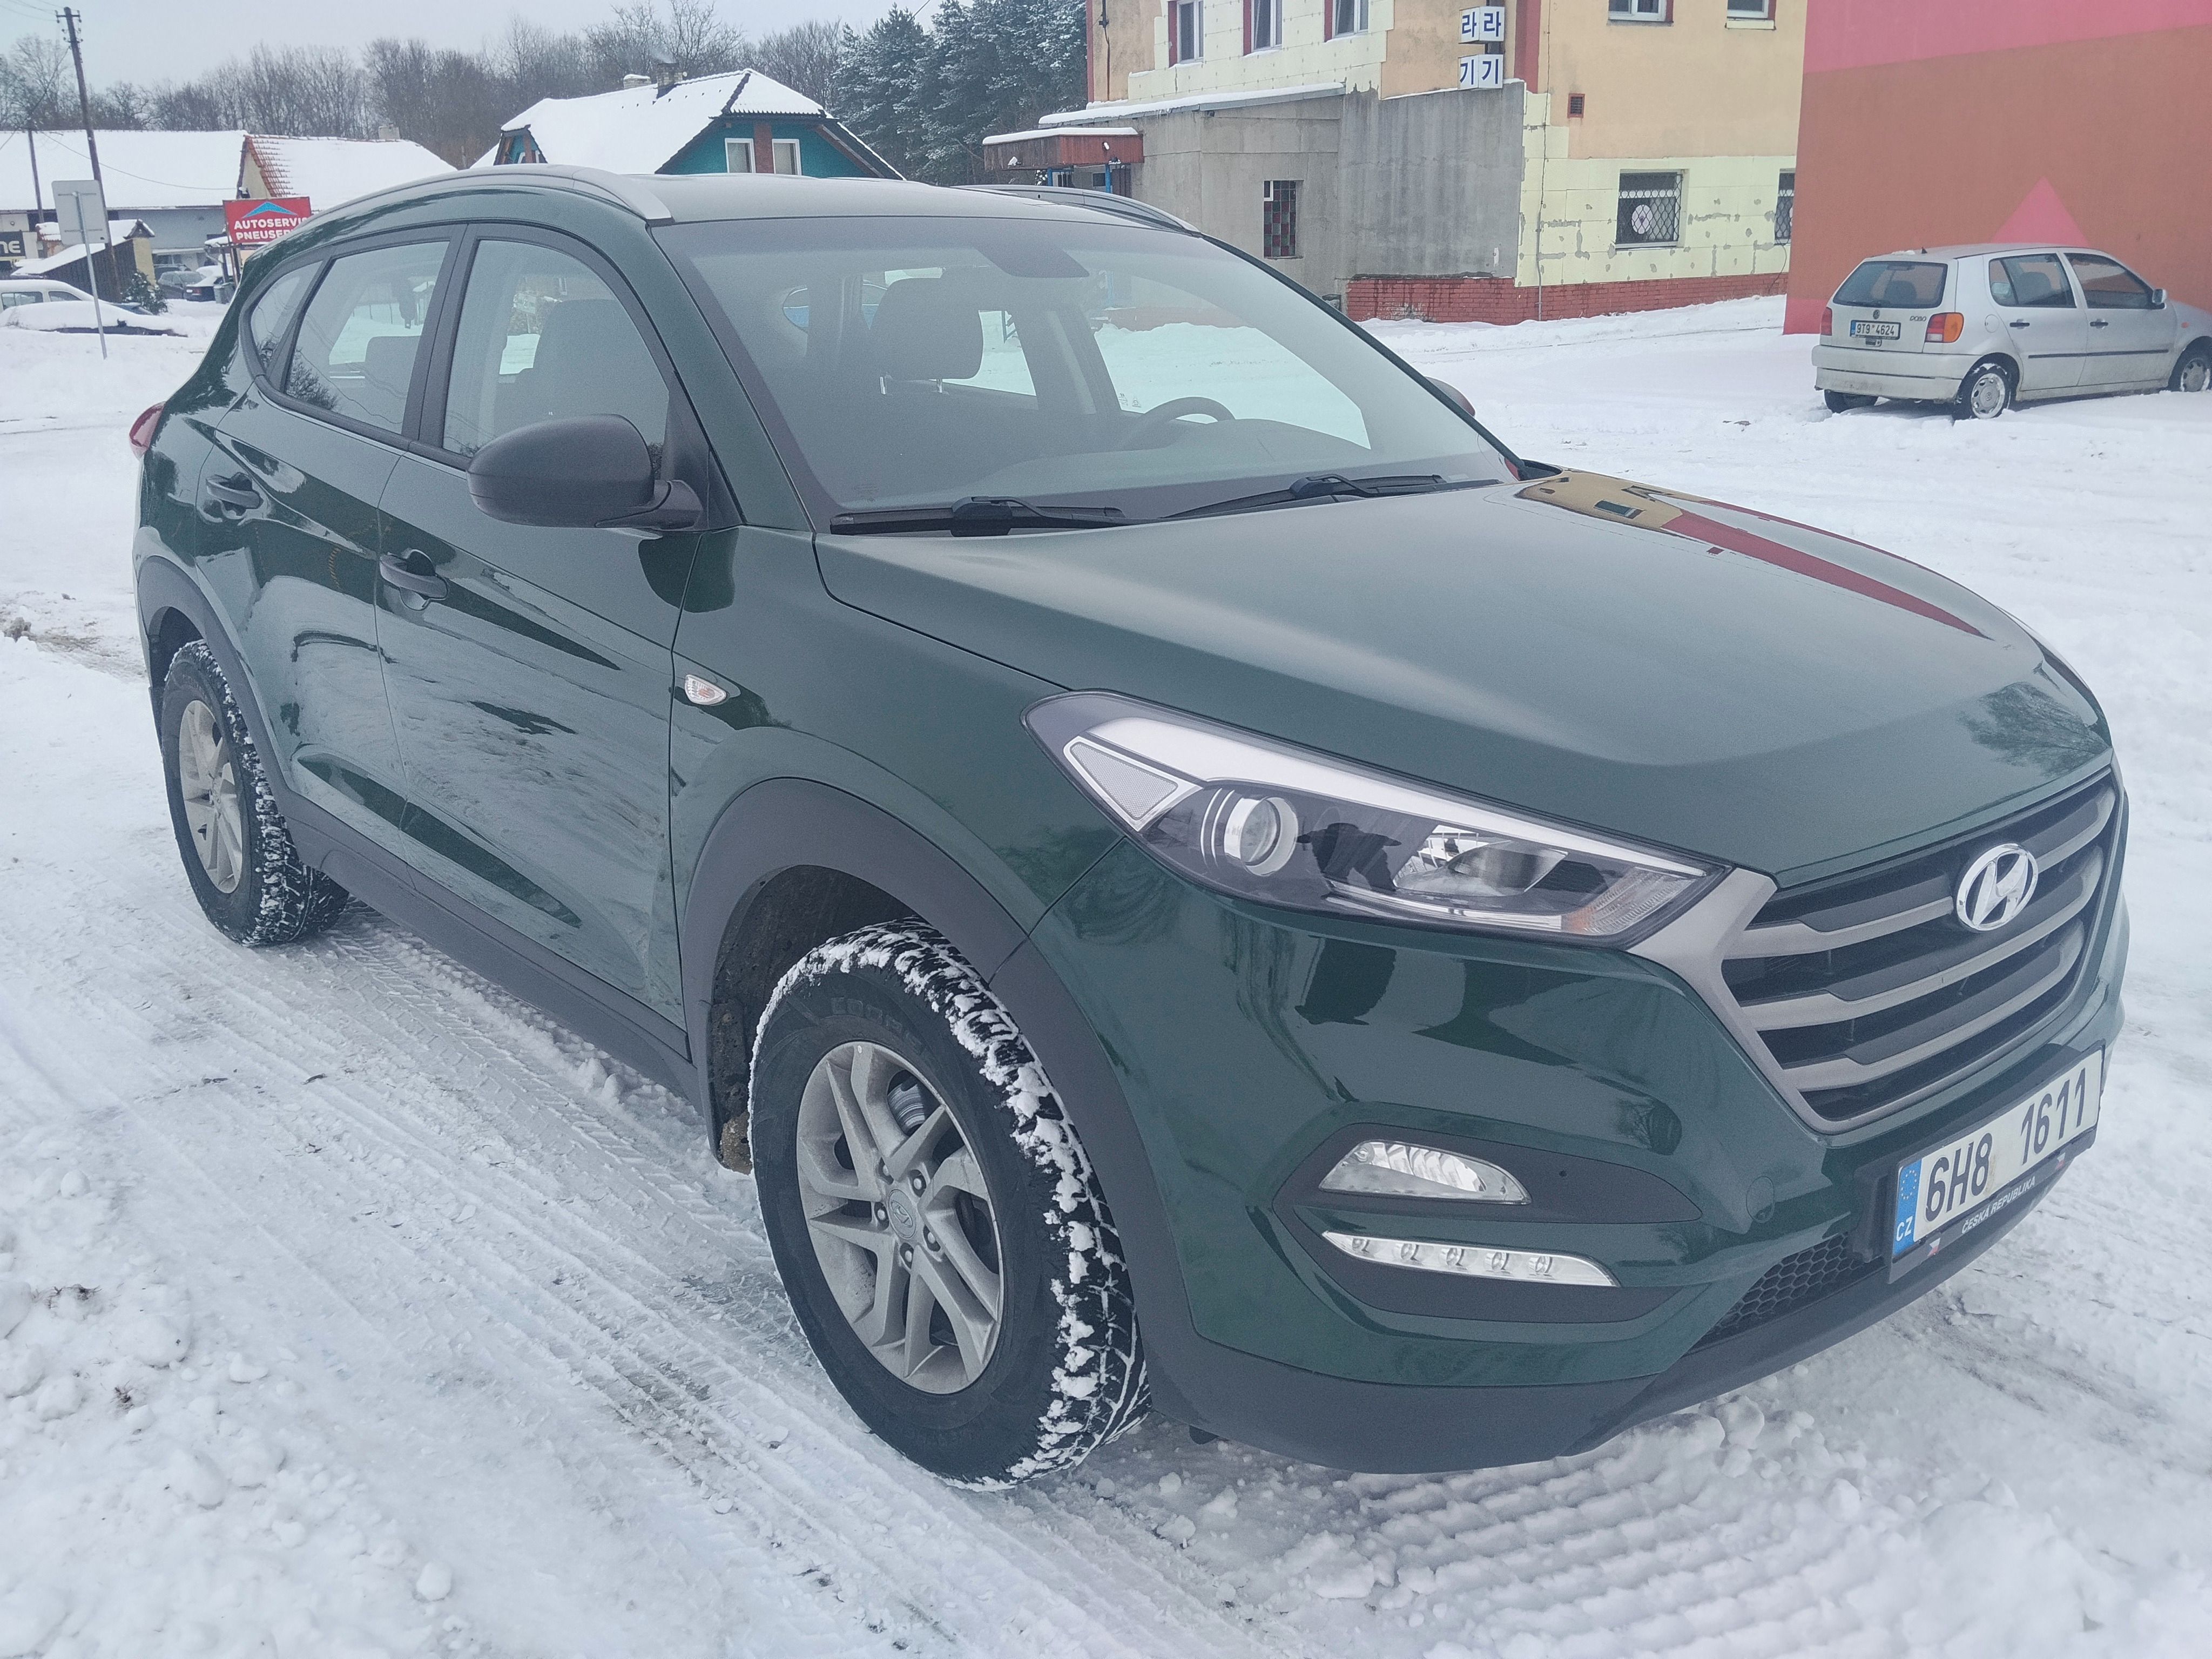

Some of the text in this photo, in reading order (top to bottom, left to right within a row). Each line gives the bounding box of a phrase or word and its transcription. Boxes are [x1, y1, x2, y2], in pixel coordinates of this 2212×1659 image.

[235, 229, 294, 240] PNEUSE
[1857, 323, 1871, 334] 9T9
[1876, 325, 1894, 335] 4624
[1925, 1067, 2086, 1222] 6H8 1611
[1961, 1176, 2035, 1235] ČESKÁ REPUBLIKA
[1896, 1216, 1913, 1242] CZ
